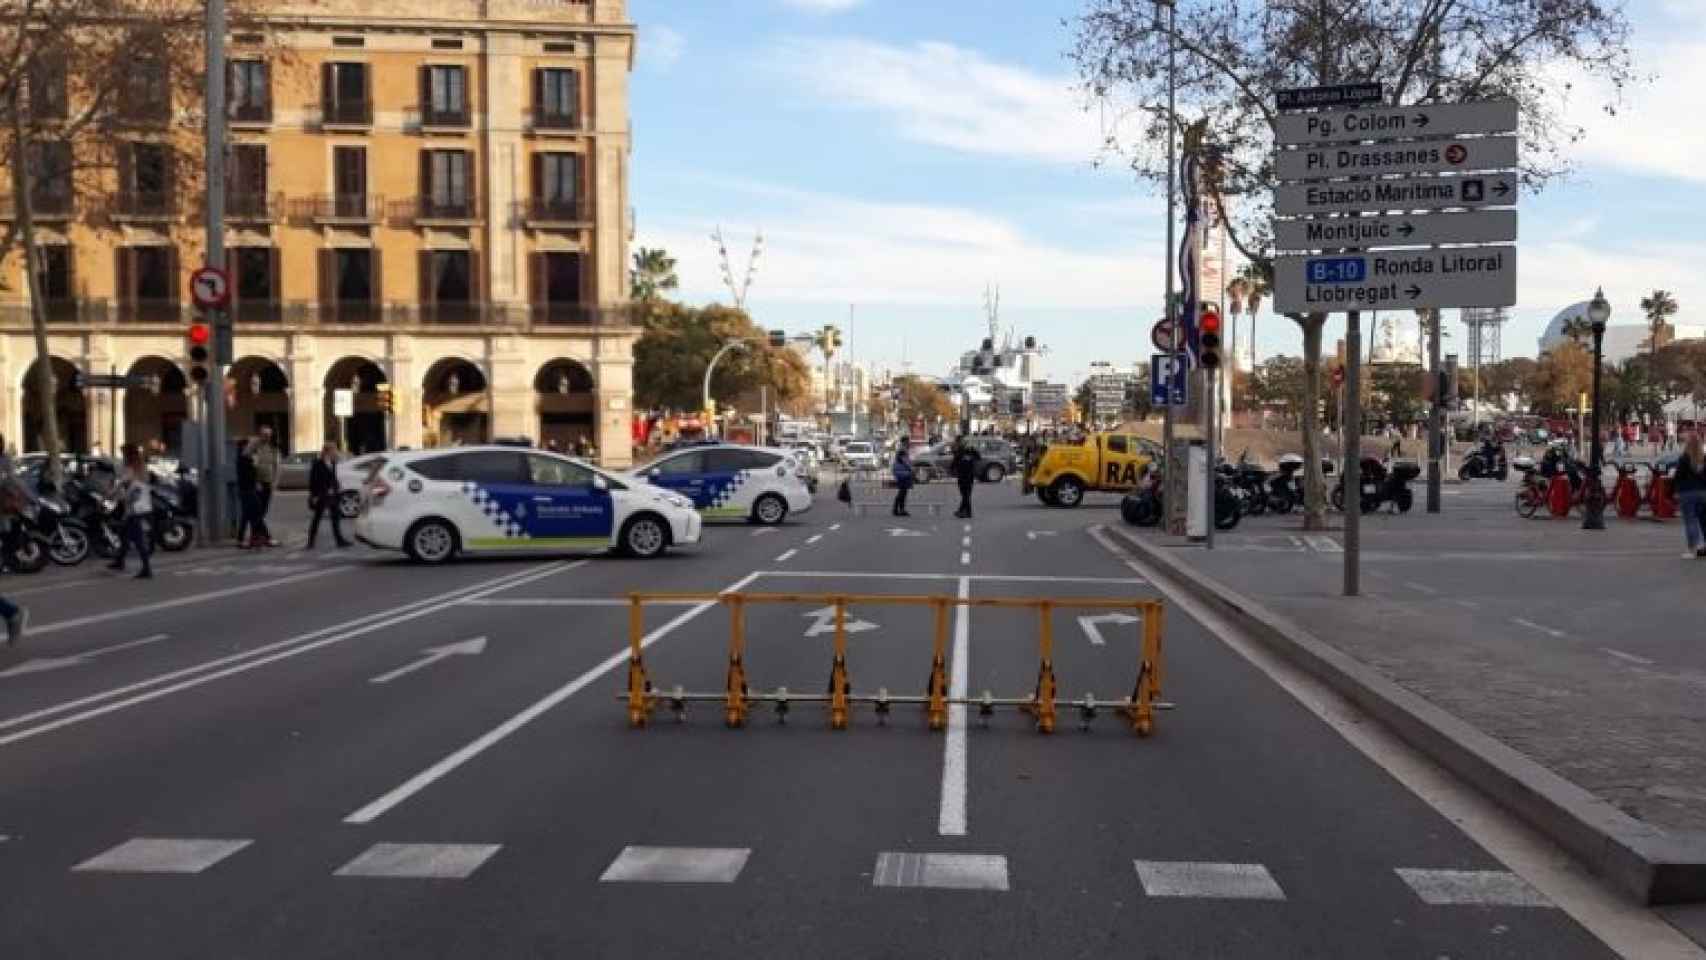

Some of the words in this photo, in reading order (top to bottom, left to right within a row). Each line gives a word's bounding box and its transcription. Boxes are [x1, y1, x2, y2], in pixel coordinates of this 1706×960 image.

[1308, 117, 1336, 135] Pg.
[1343, 114, 1406, 131] Colom
[1307, 153, 1329, 169] Pl.
[1337, 148, 1440, 168] Drassanes
[1313, 262, 1358, 280] B-10
[1375, 258, 1433, 275] Ronda
[1442, 252, 1502, 272] Litoral
[1306, 283, 1397, 304] Llobregat
